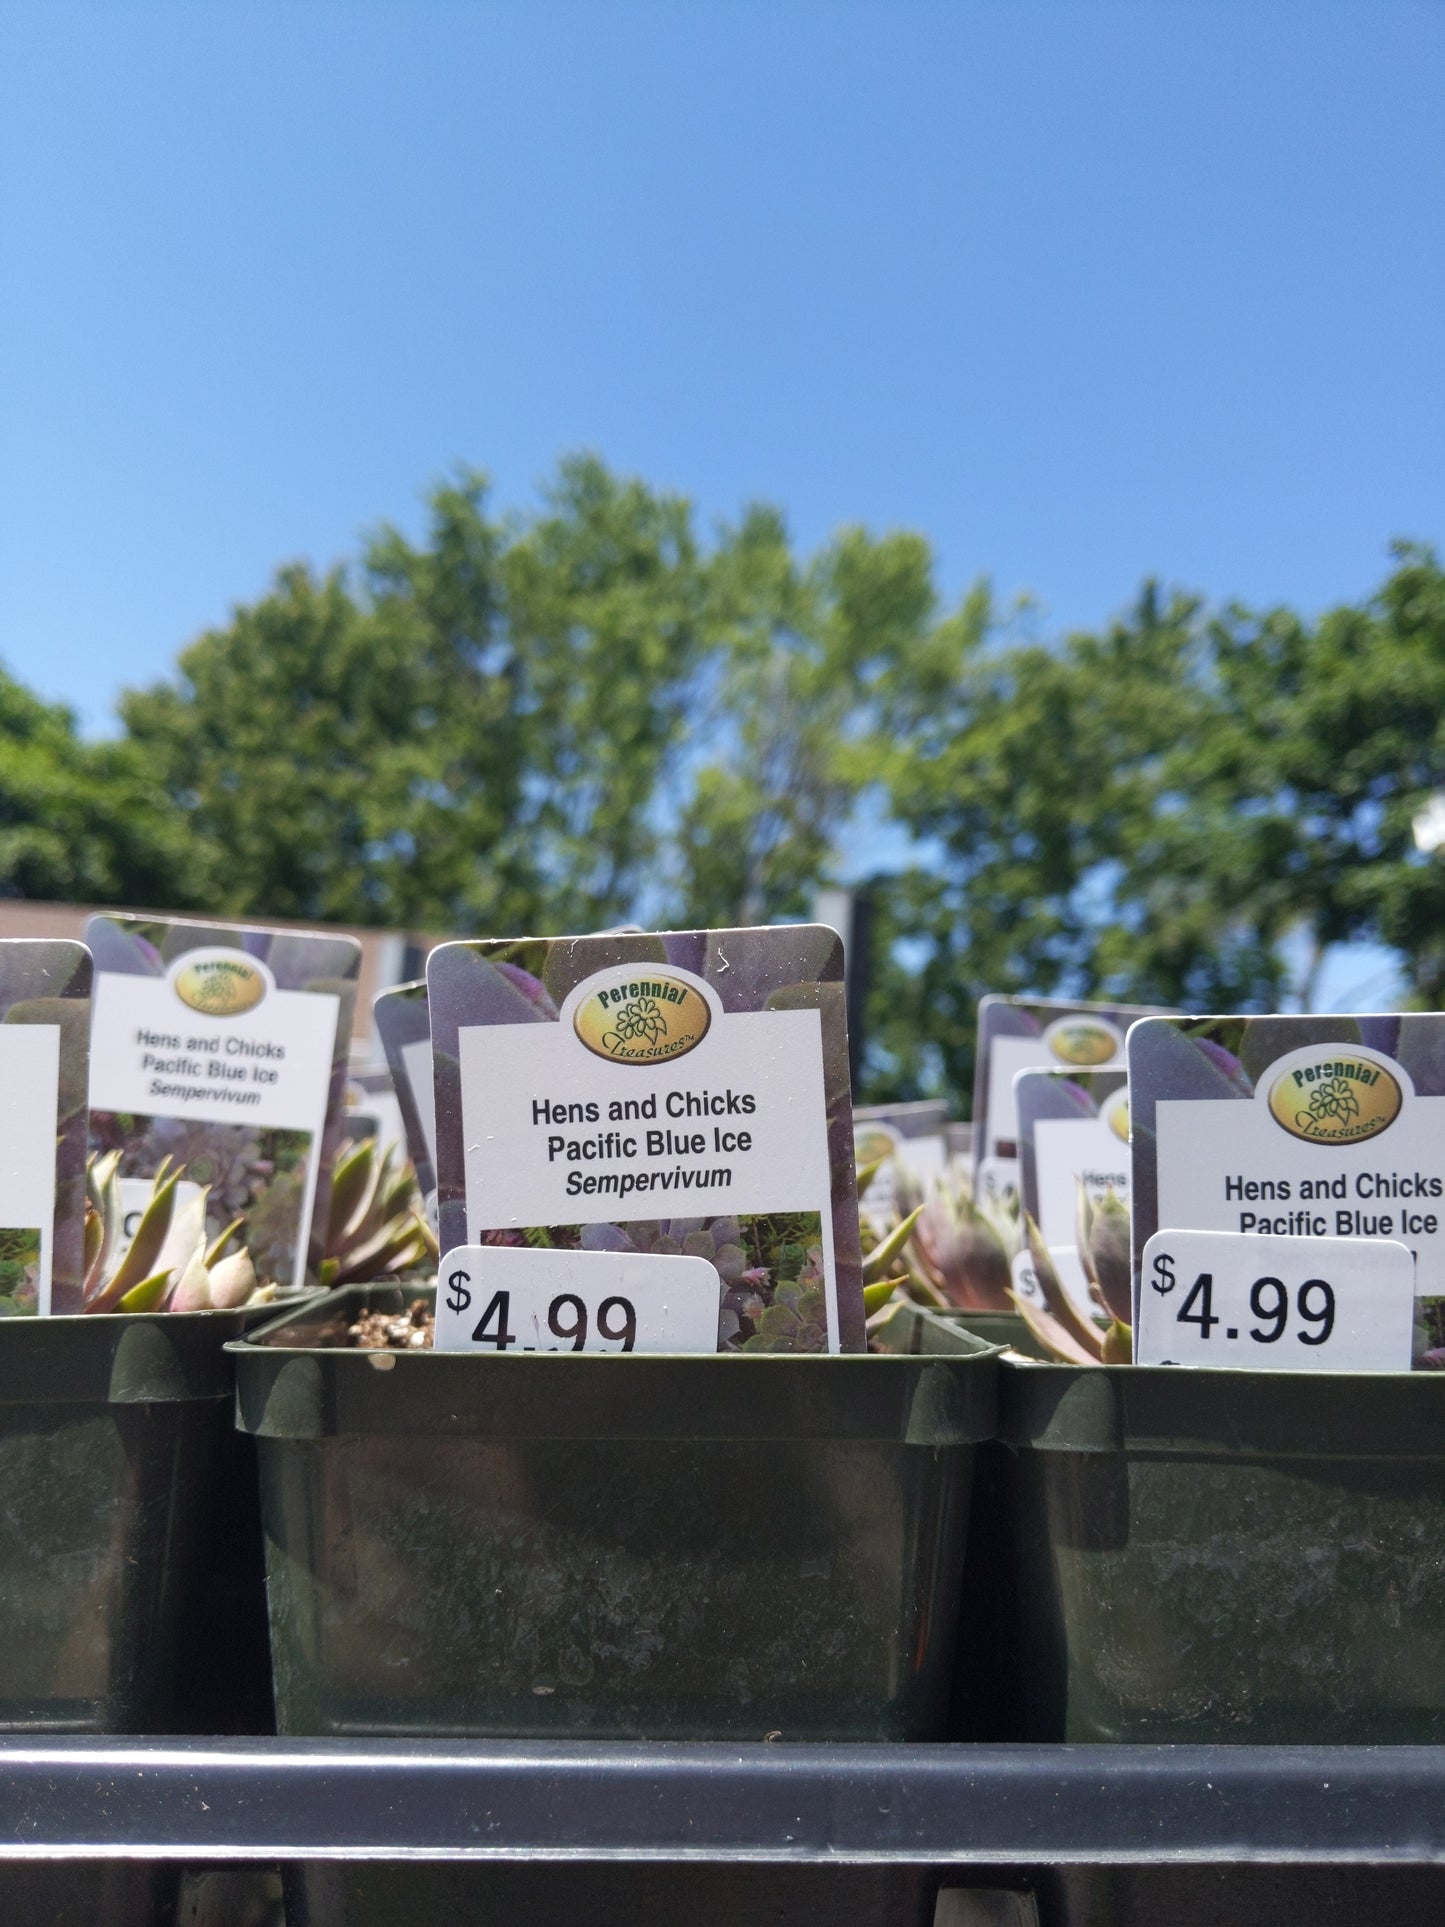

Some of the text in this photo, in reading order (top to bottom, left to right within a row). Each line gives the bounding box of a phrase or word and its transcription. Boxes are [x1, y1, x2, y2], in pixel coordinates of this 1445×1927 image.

[597, 981, 688, 1009] Perennial
[136, 1030, 286, 1060] Hens and Chicks
[142, 1054, 278, 1085] Pacific Blue Ice
[1292, 1062, 1381, 1088] Perennial
[150, 1078, 261, 1105] Sempervivum
[532, 1089, 757, 1125] Hens and Chicks
[548, 1126, 753, 1162] Pacific Blue Ice
[565, 1165, 732, 1199] Sempervivum
[1225, 1172, 1443, 1201] Hens and Chicks
[1240, 1209, 1438, 1237] Pacific Blue Ice
[1151, 1253, 1336, 1346] $4.99
